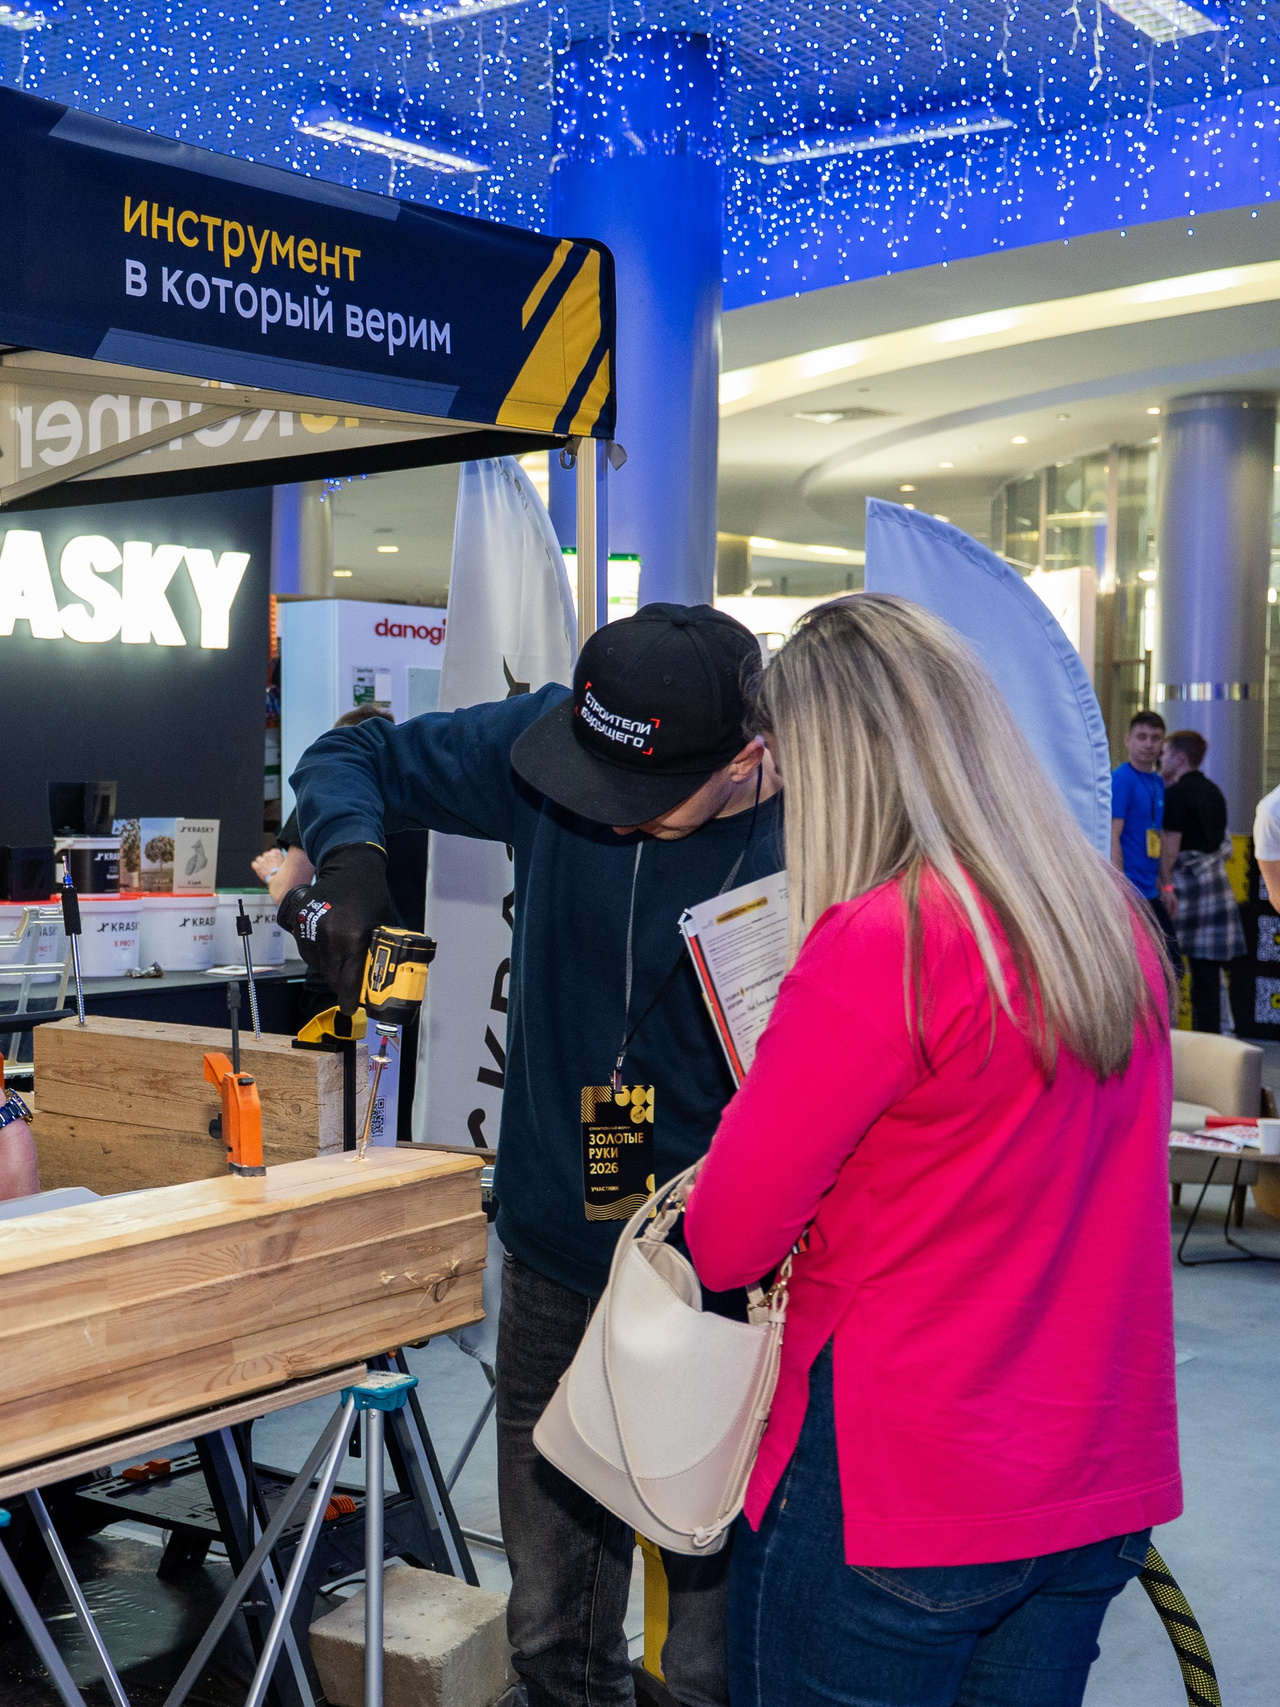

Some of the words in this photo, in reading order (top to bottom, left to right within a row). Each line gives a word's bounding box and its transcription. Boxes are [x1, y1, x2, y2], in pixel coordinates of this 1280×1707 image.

[123, 196, 361, 281] инструмент
[125, 259, 148, 297] в
[162, 267, 334, 334] который
[346, 304, 452, 356] верим
[375, 618, 447, 645] danogi
[581, 707, 645, 748] БУДУЩЕГО
[585, 692, 652, 735] СТРОИТЕЛИ
[589, 1132, 644, 1145] ЗОЛОТЫЕ
[589, 1147, 619, 1160] РУКИ
[589, 1162, 619, 1175] 2026
